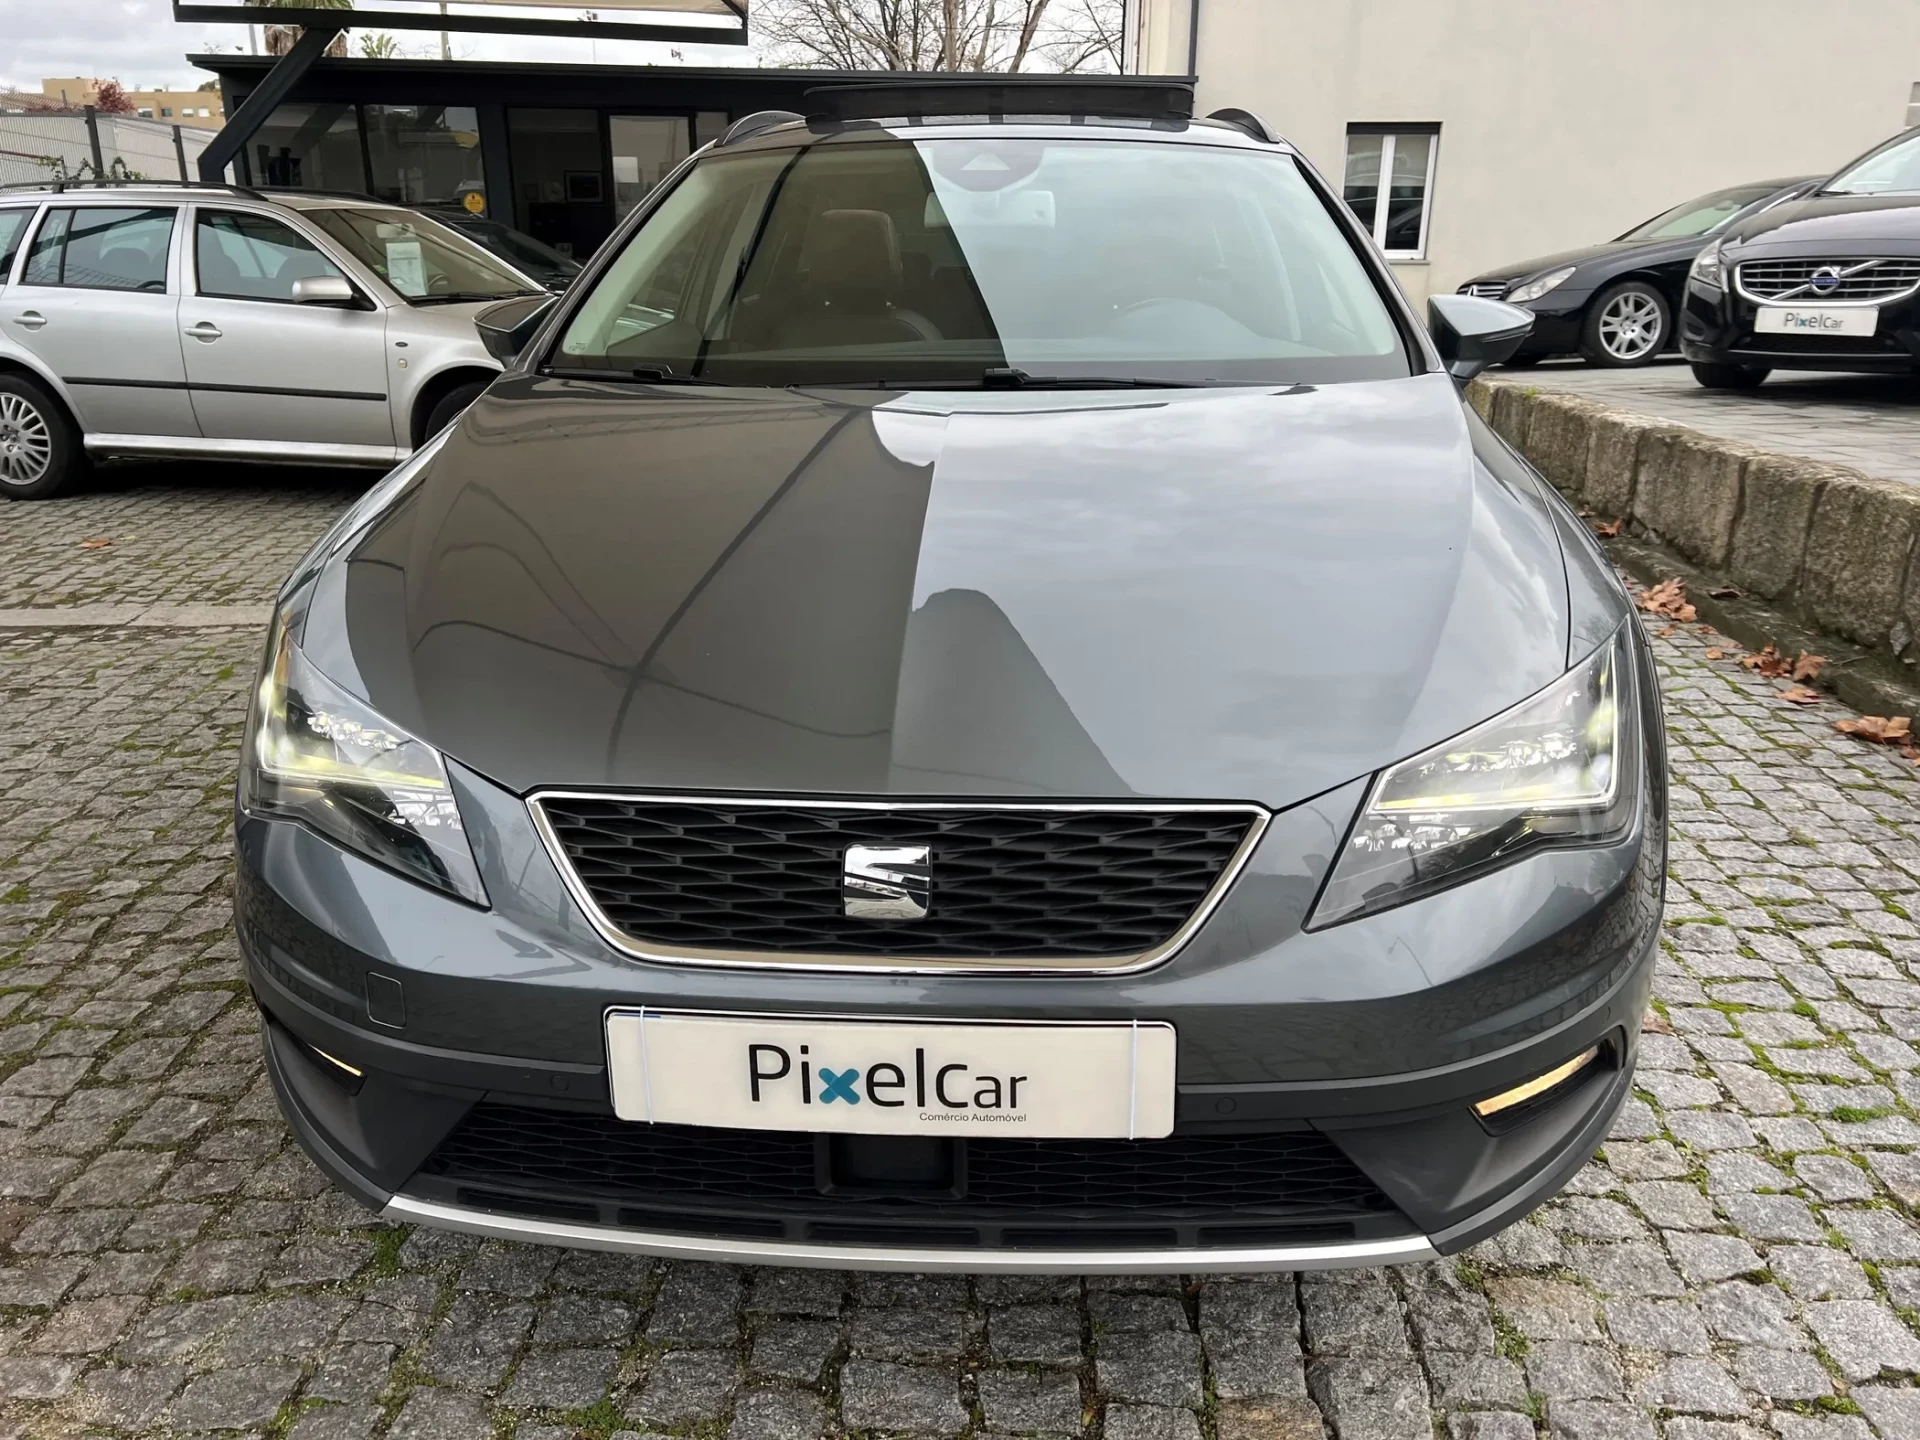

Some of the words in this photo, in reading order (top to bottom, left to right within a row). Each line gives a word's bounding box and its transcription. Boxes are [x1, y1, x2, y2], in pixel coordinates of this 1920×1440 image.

[748, 1044, 1028, 1108] PixelCar
[919, 1112, 969, 1122] Comércio
[971, 1113, 1027, 1122] Automóvel
